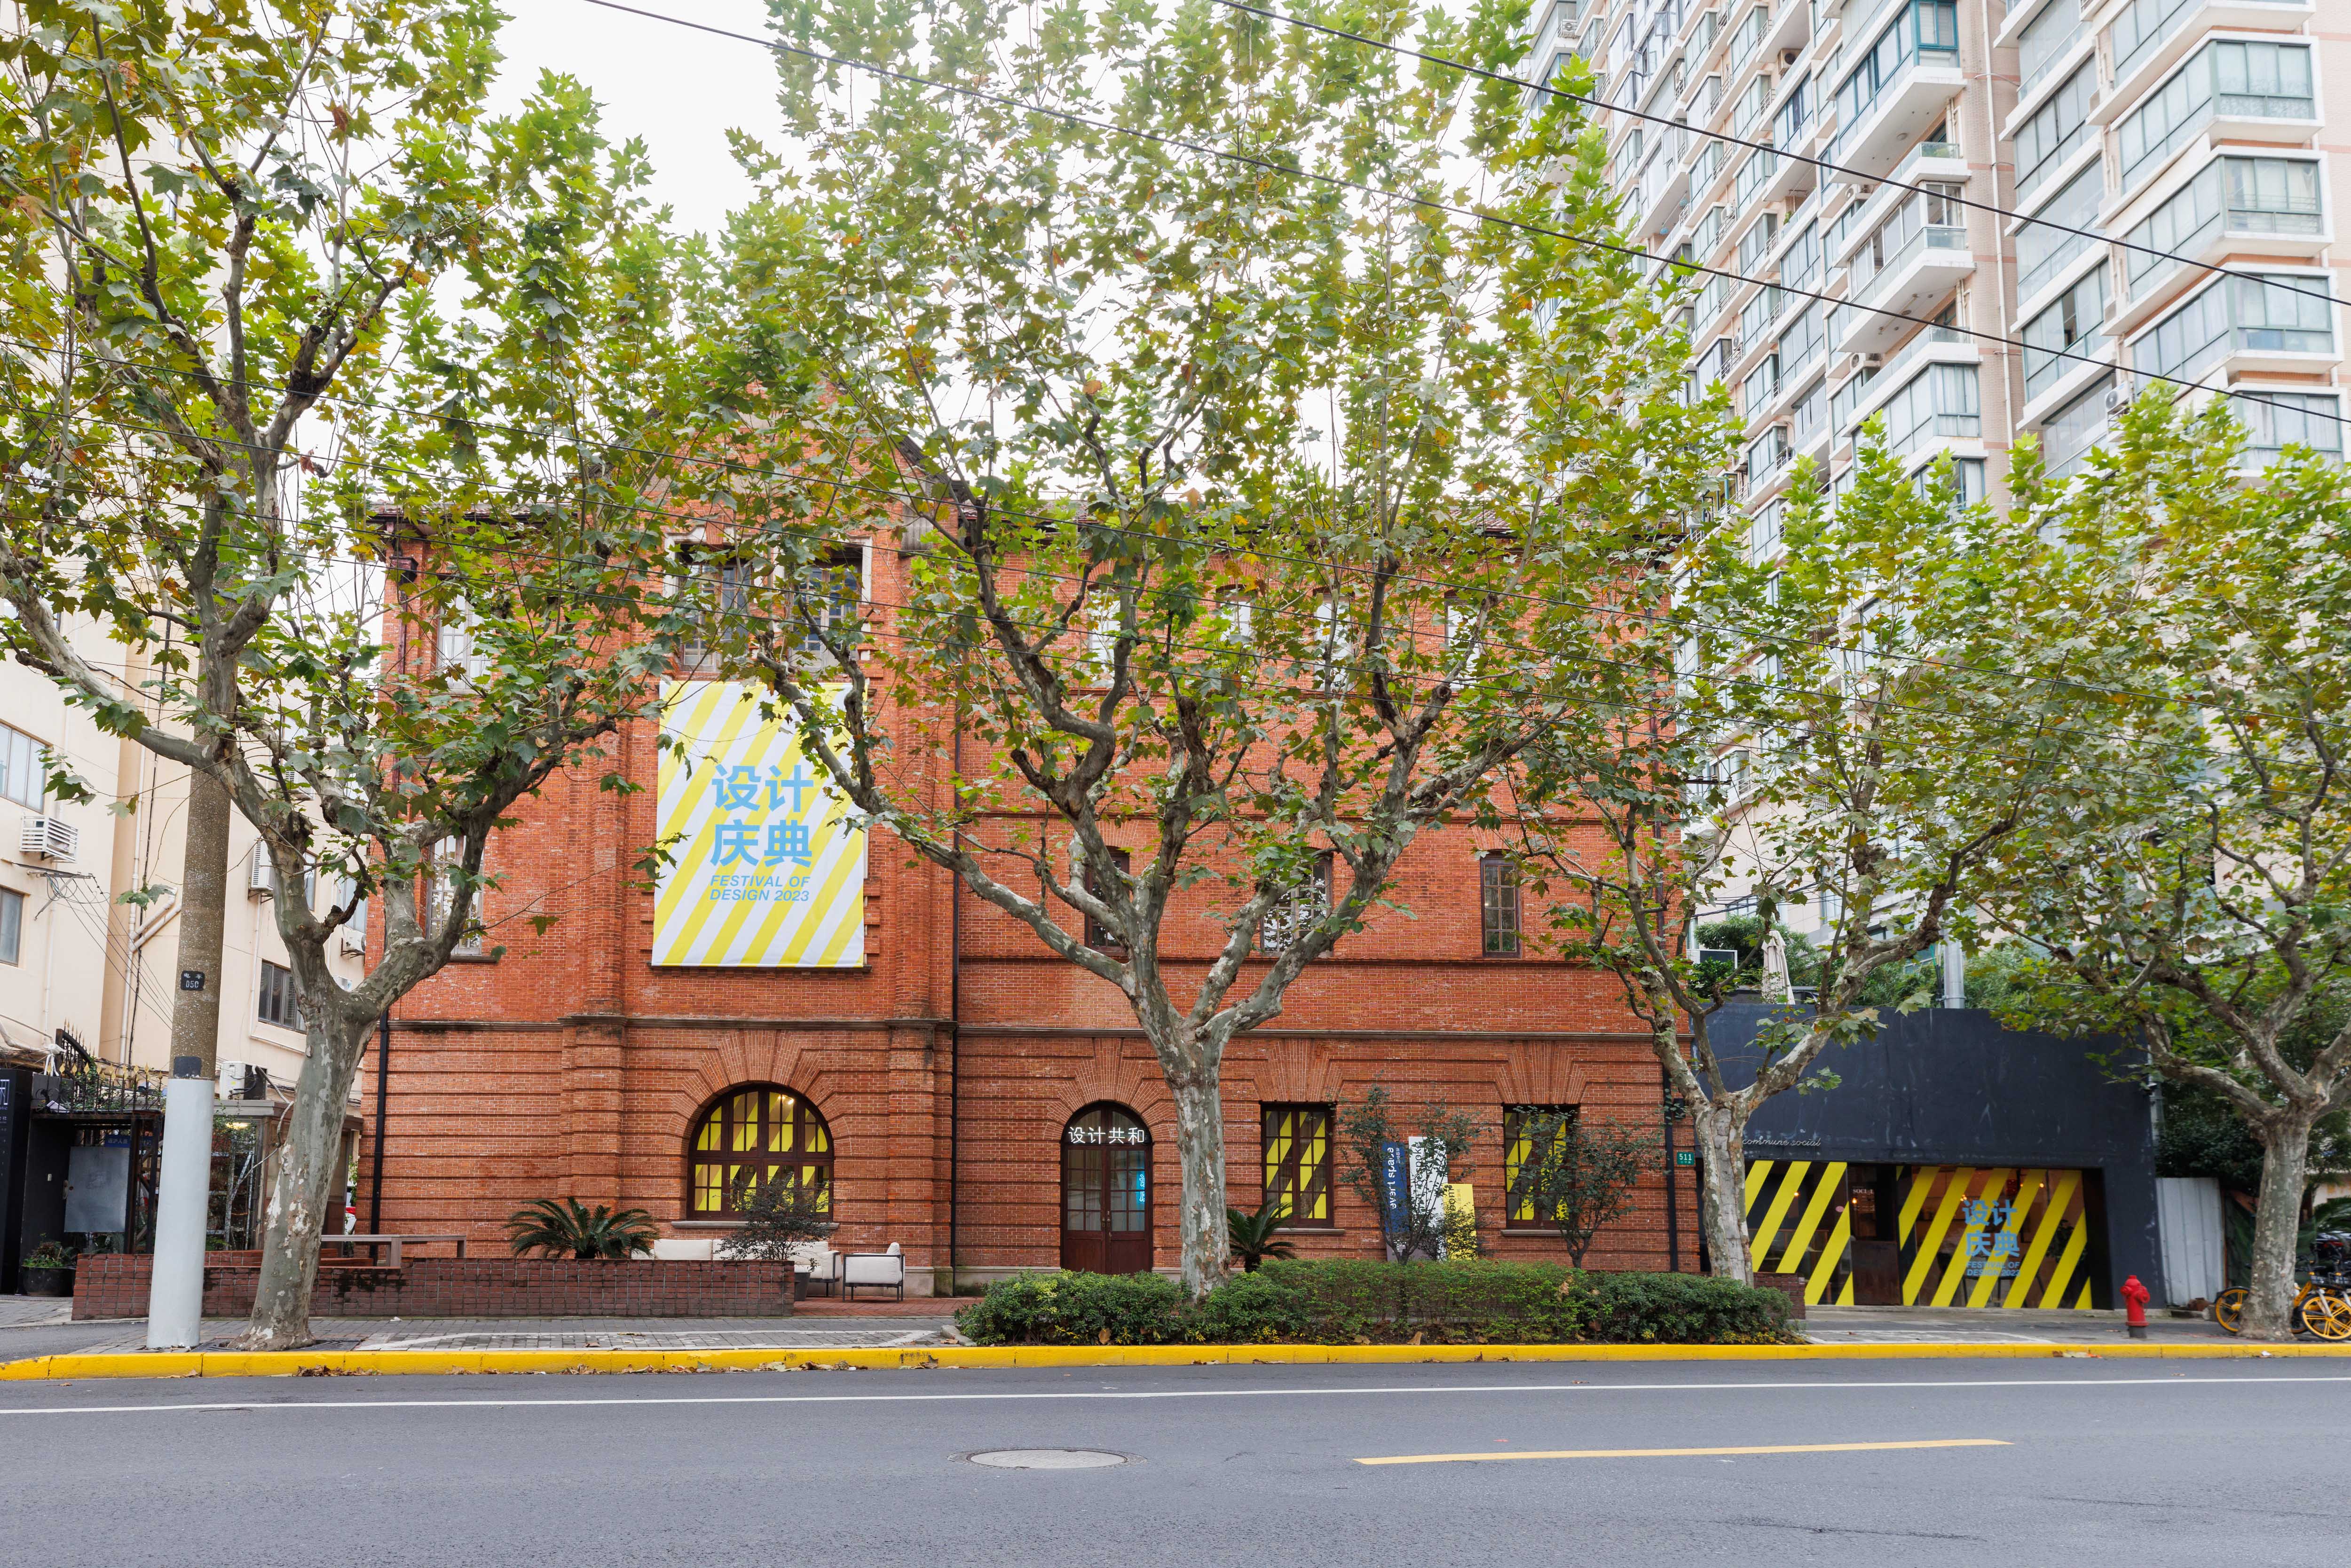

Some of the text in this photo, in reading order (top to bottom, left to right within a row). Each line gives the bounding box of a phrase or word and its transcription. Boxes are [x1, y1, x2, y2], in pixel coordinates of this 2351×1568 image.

[711, 764, 814, 812] 设计
[710, 819, 812, 868] 庆典
[710, 875, 810, 888] FESTIVAL OF
[710, 889, 809, 901] DESIGN 2023
[1068, 1126, 1144, 1145] 设计共和
[1790, 1137, 1821, 1146] social
[1962, 1199, 2017, 1227] 设计
[1965, 1230, 2020, 1257] 庆典
